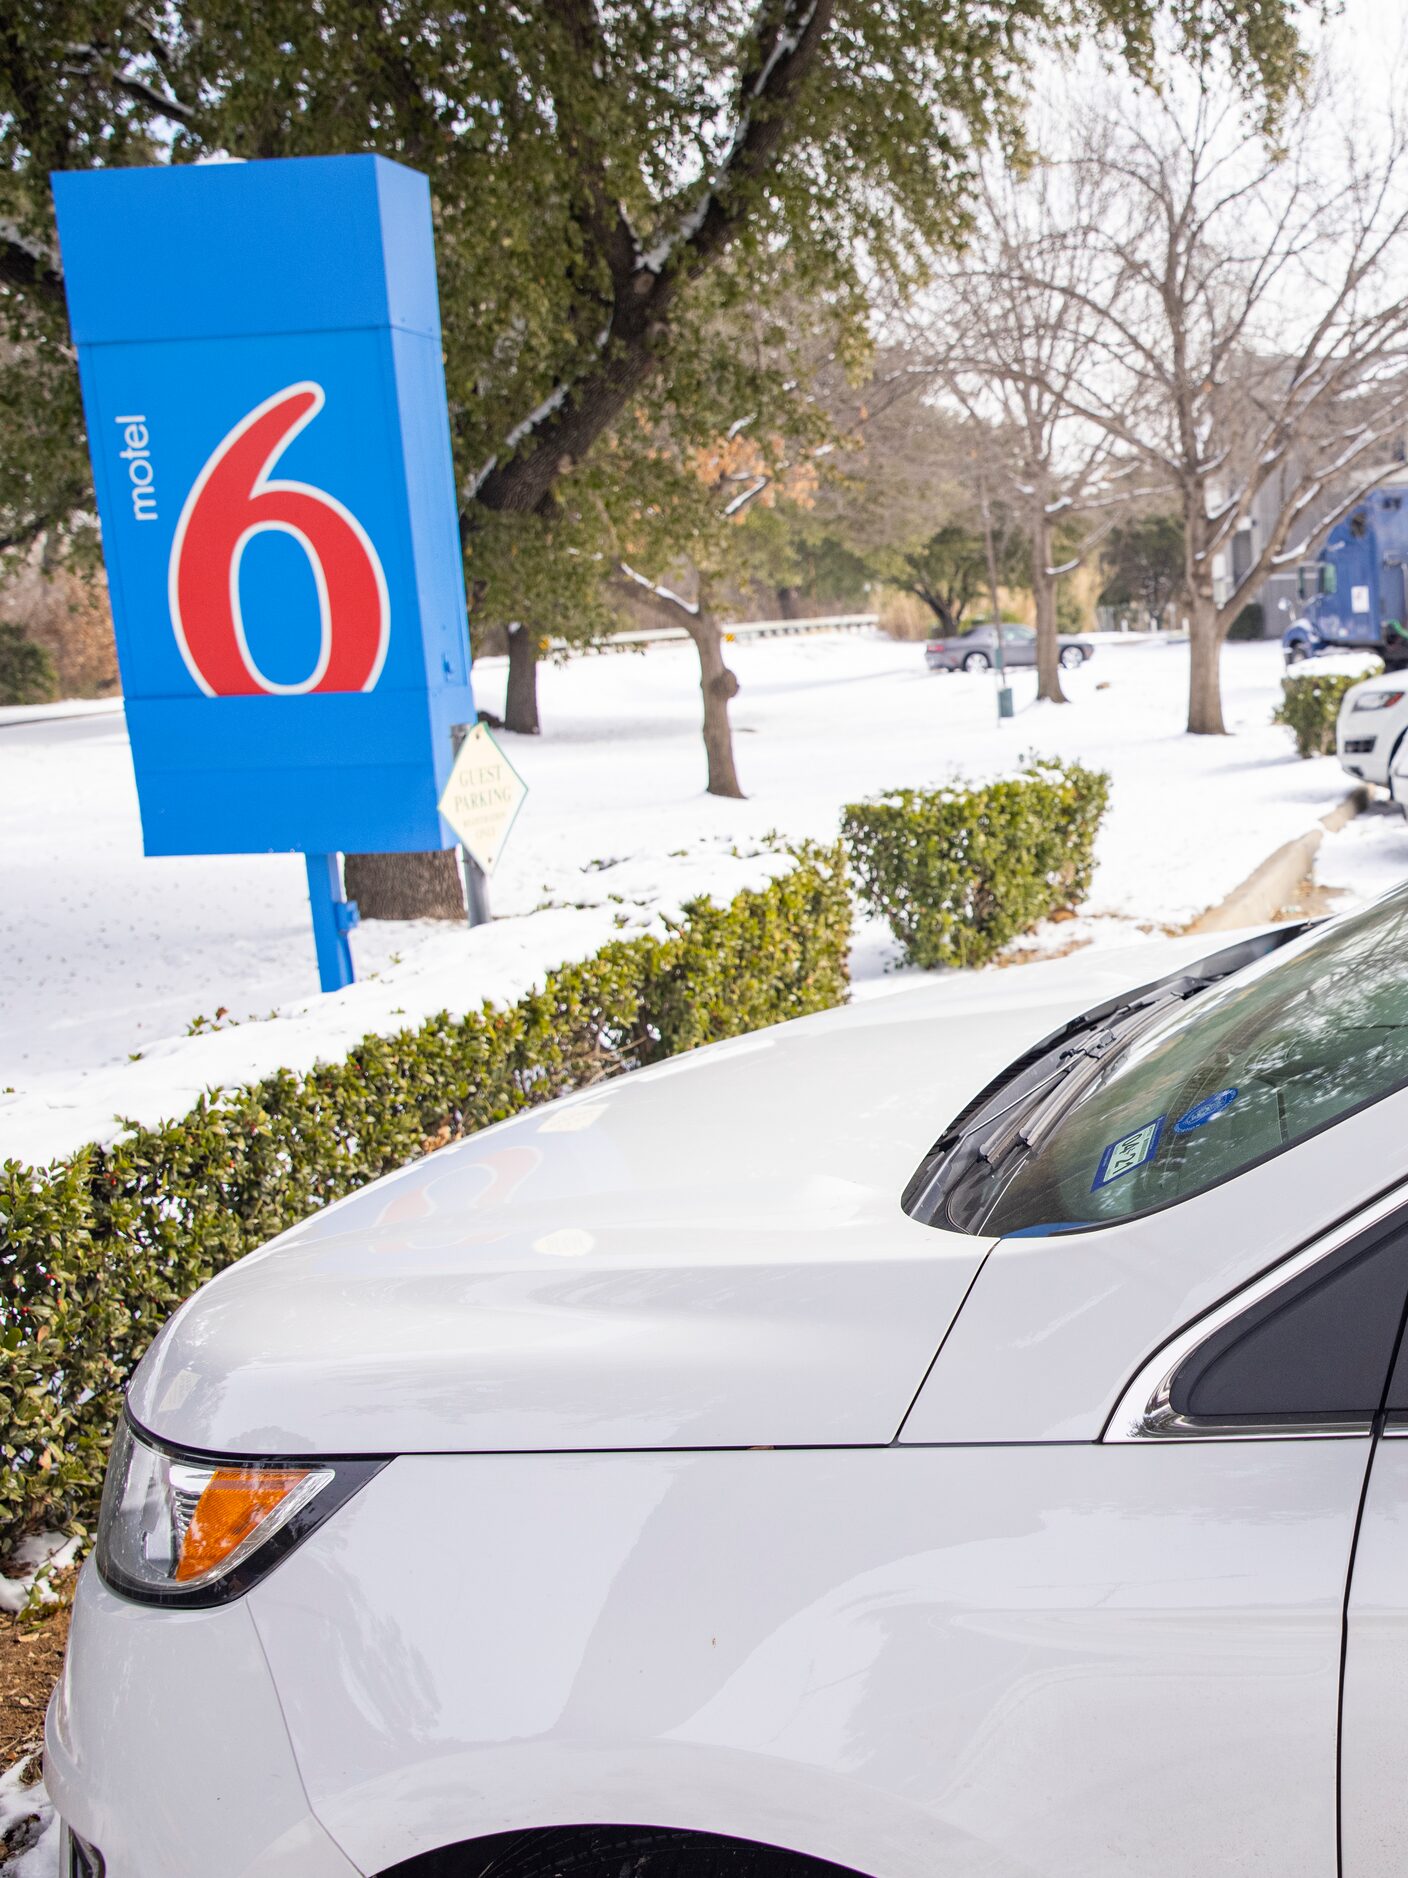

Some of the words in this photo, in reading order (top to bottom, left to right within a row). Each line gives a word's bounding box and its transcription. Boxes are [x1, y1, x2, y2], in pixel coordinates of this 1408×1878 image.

[115, 415, 158, 521] motel
[168, 380, 391, 697] 6
[454, 787, 511, 813] PARKING
[460, 765, 502, 787] GUEST
